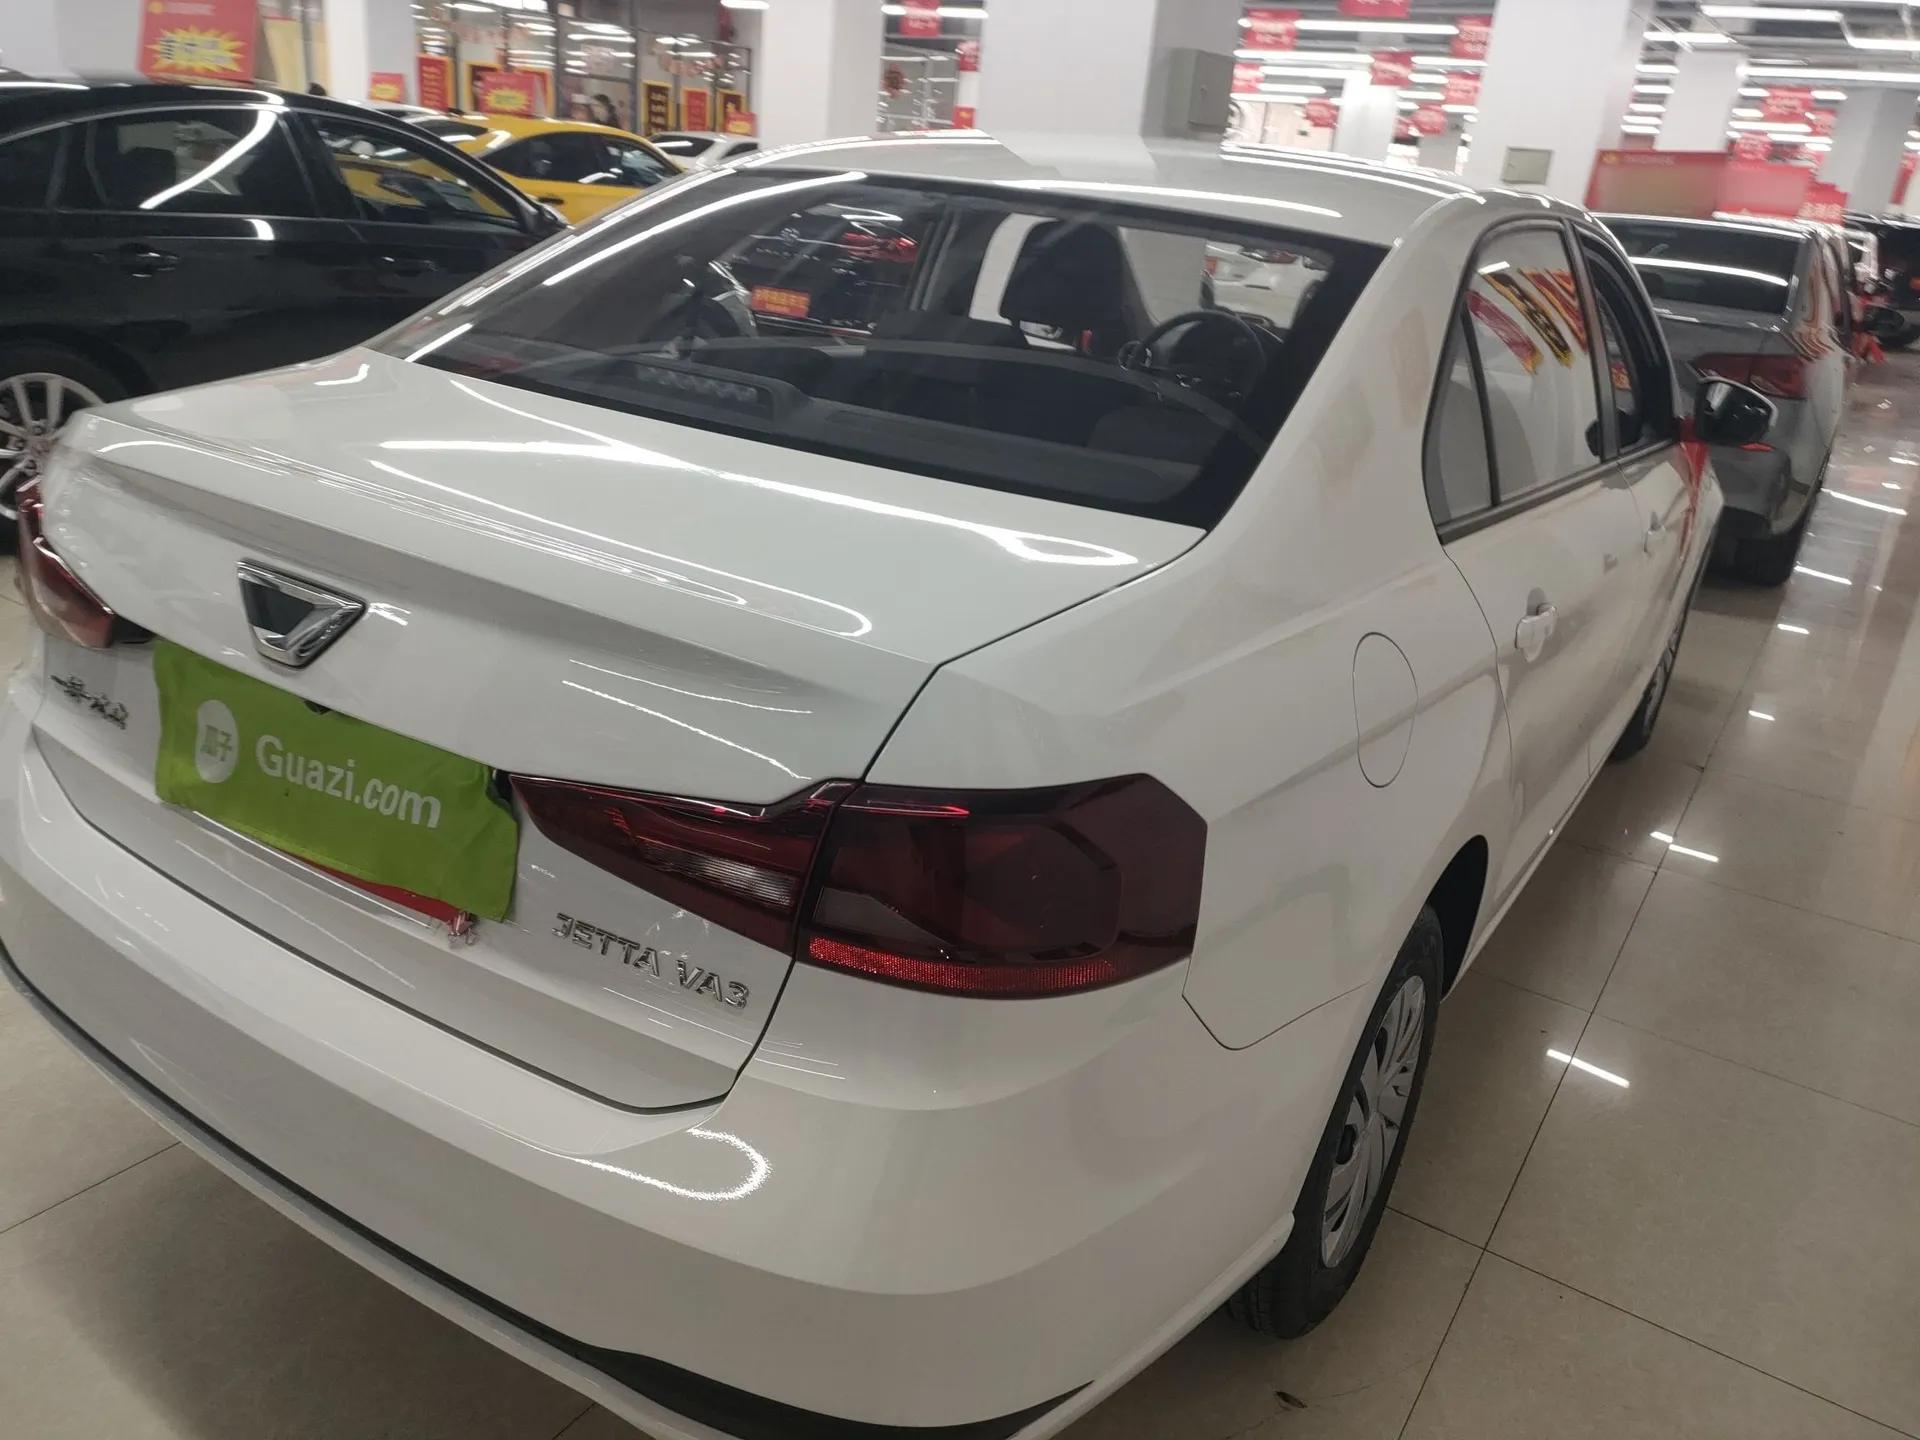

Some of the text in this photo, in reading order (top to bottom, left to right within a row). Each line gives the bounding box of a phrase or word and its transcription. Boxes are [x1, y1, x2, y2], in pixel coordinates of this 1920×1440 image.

[255, 734, 442, 829] Guazi.com
[551, 912, 751, 1009] JETTA VA3
